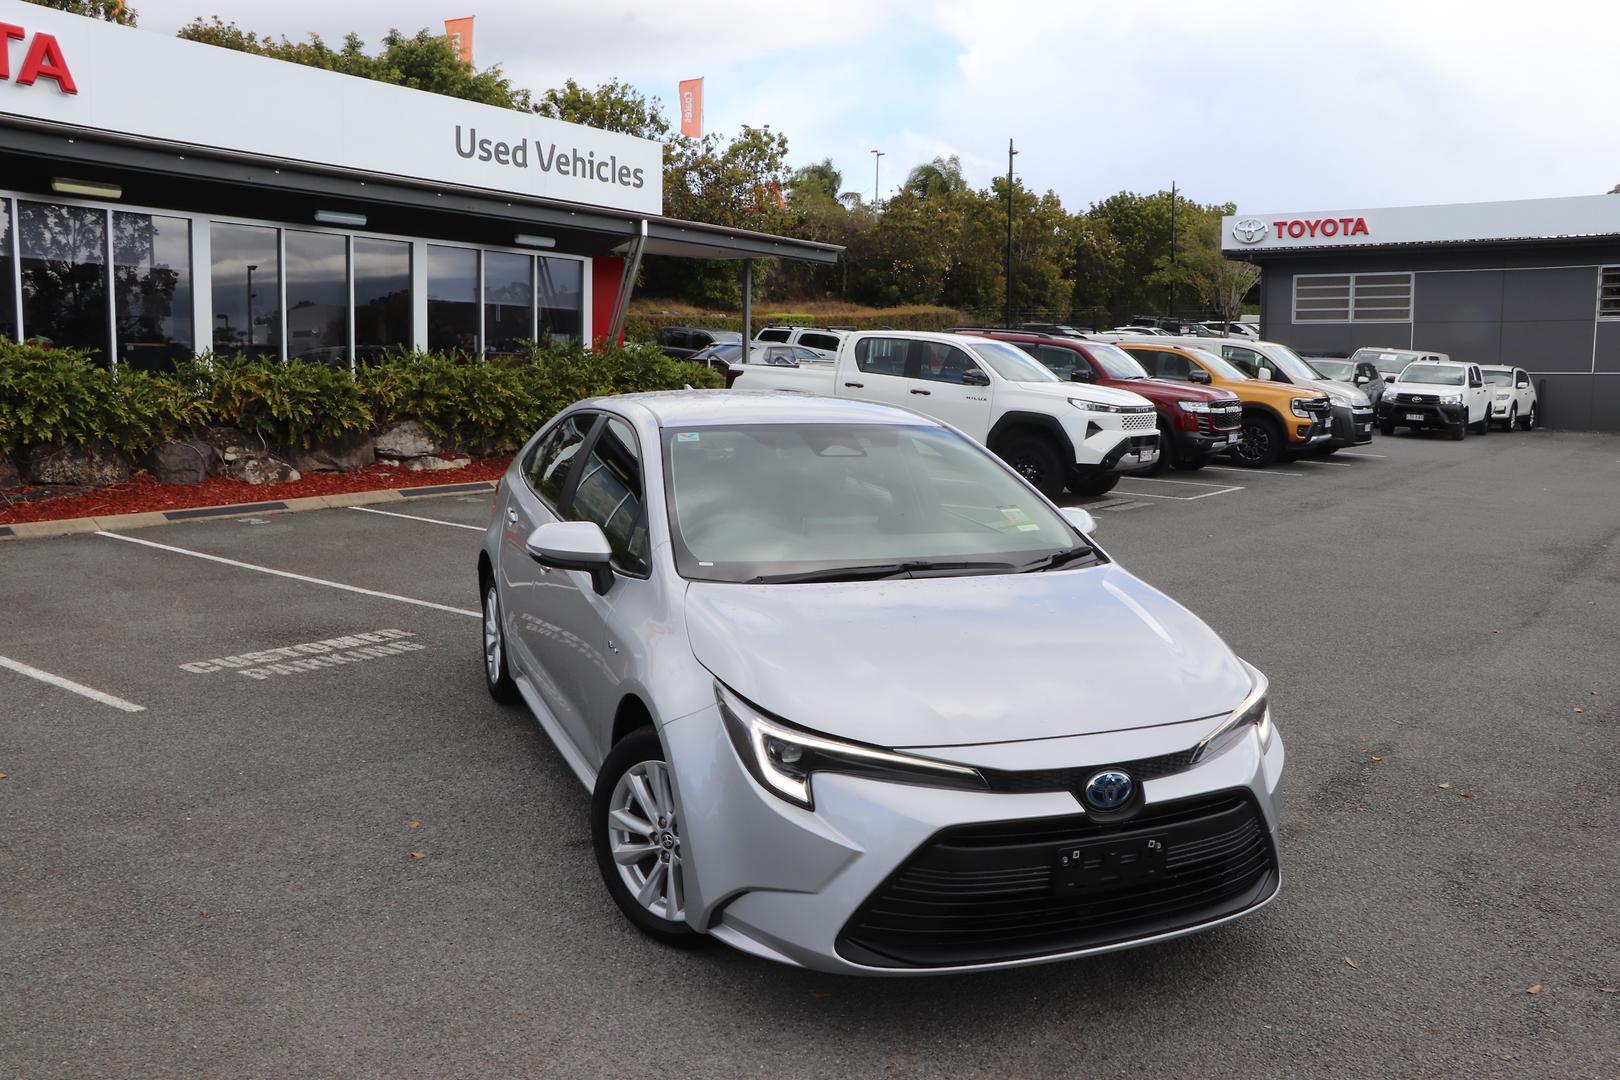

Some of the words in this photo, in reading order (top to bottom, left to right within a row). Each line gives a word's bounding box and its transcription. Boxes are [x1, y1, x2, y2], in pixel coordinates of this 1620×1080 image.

[455, 124, 528, 168] Used
[535, 140, 644, 188] Vehicles
[1273, 217, 1369, 239] TOYOTA
[178, 628, 416, 674] CUSTOMER
[237, 641, 427, 680] PARKING
